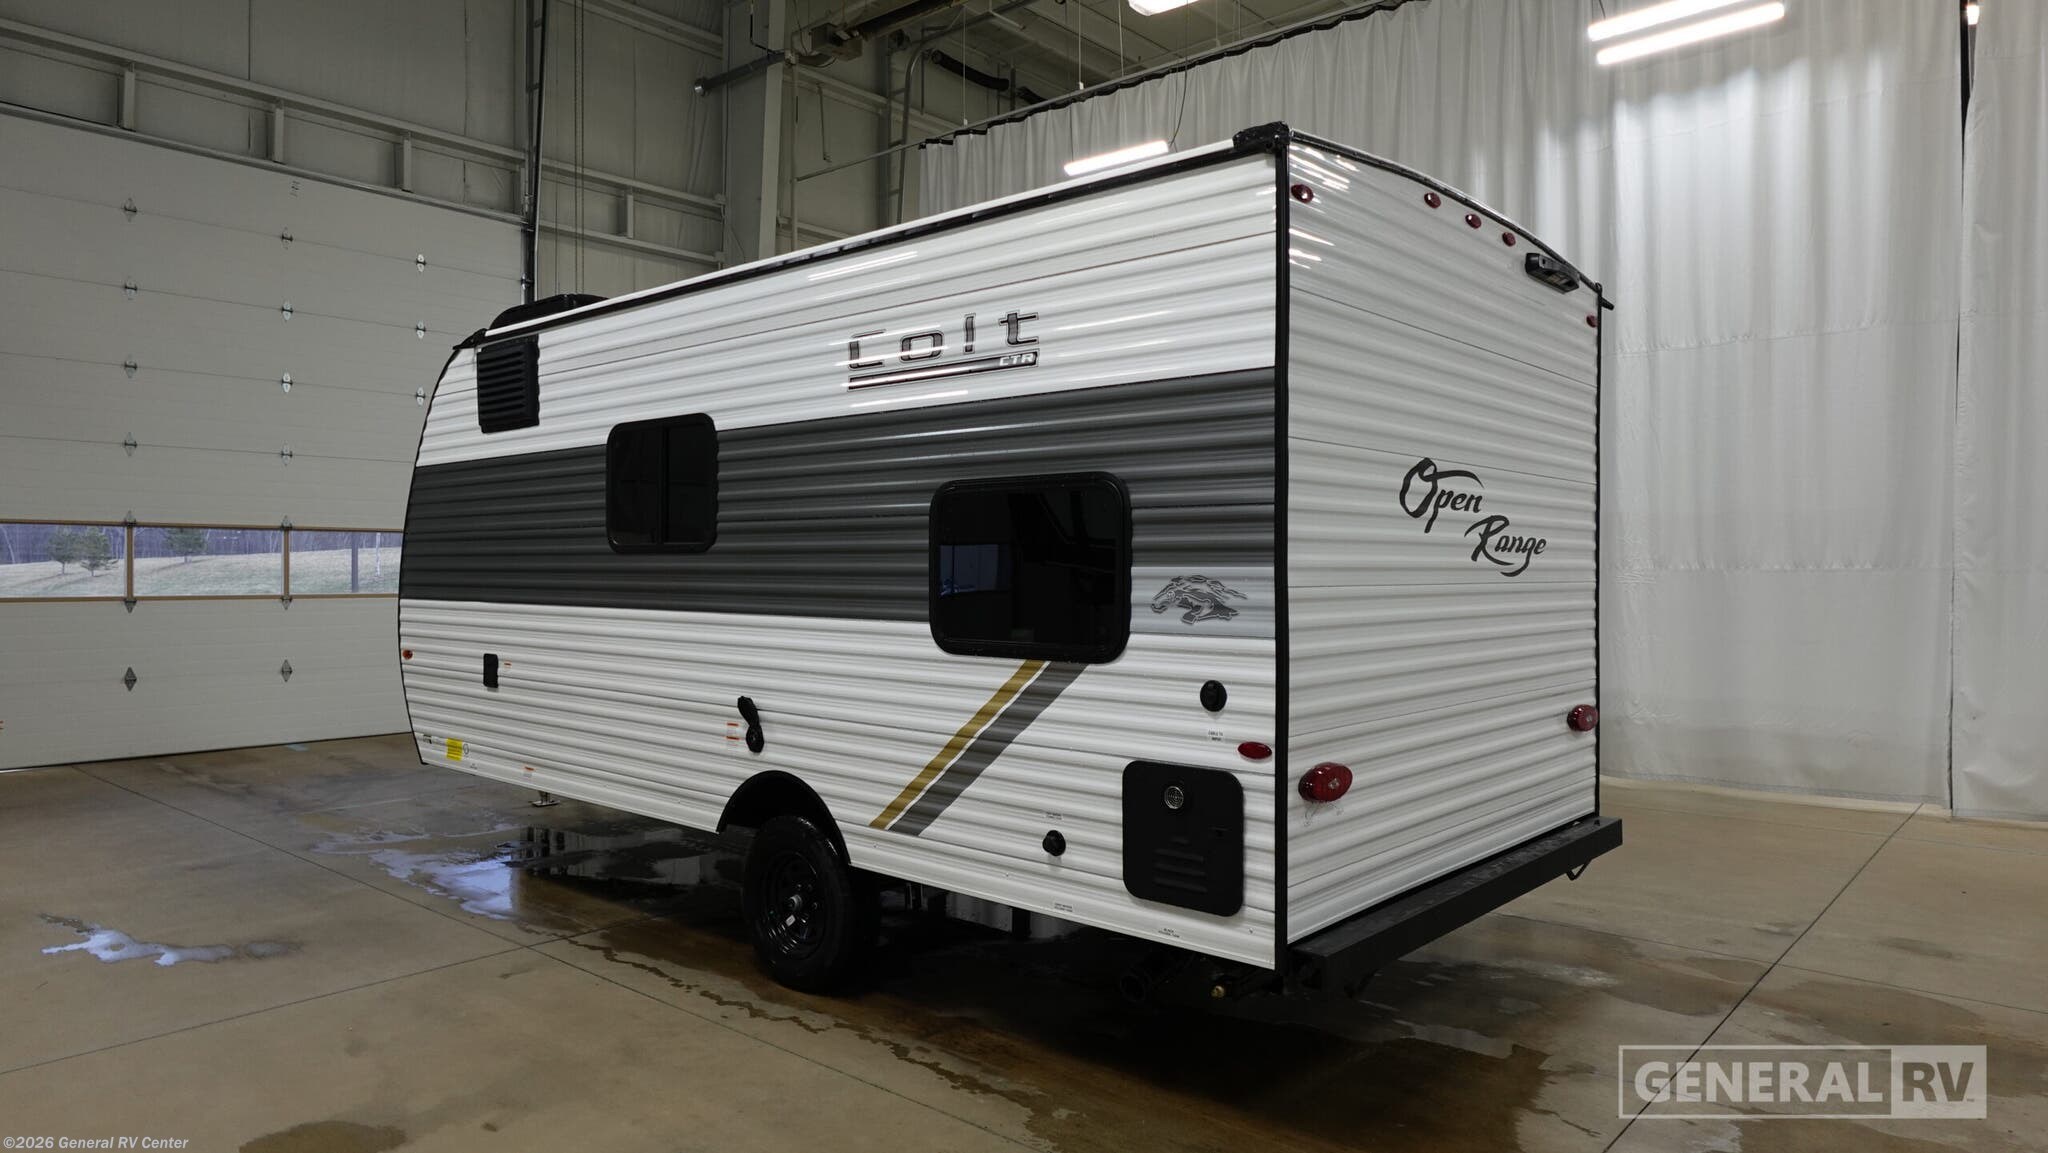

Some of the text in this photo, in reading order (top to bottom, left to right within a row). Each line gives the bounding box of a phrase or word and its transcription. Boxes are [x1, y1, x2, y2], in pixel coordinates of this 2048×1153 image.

[848, 310, 1039, 369] Colt
[999, 353, 1035, 367] CTR
[1399, 457, 1485, 534] Open
[1464, 515, 1547, 577] Range
